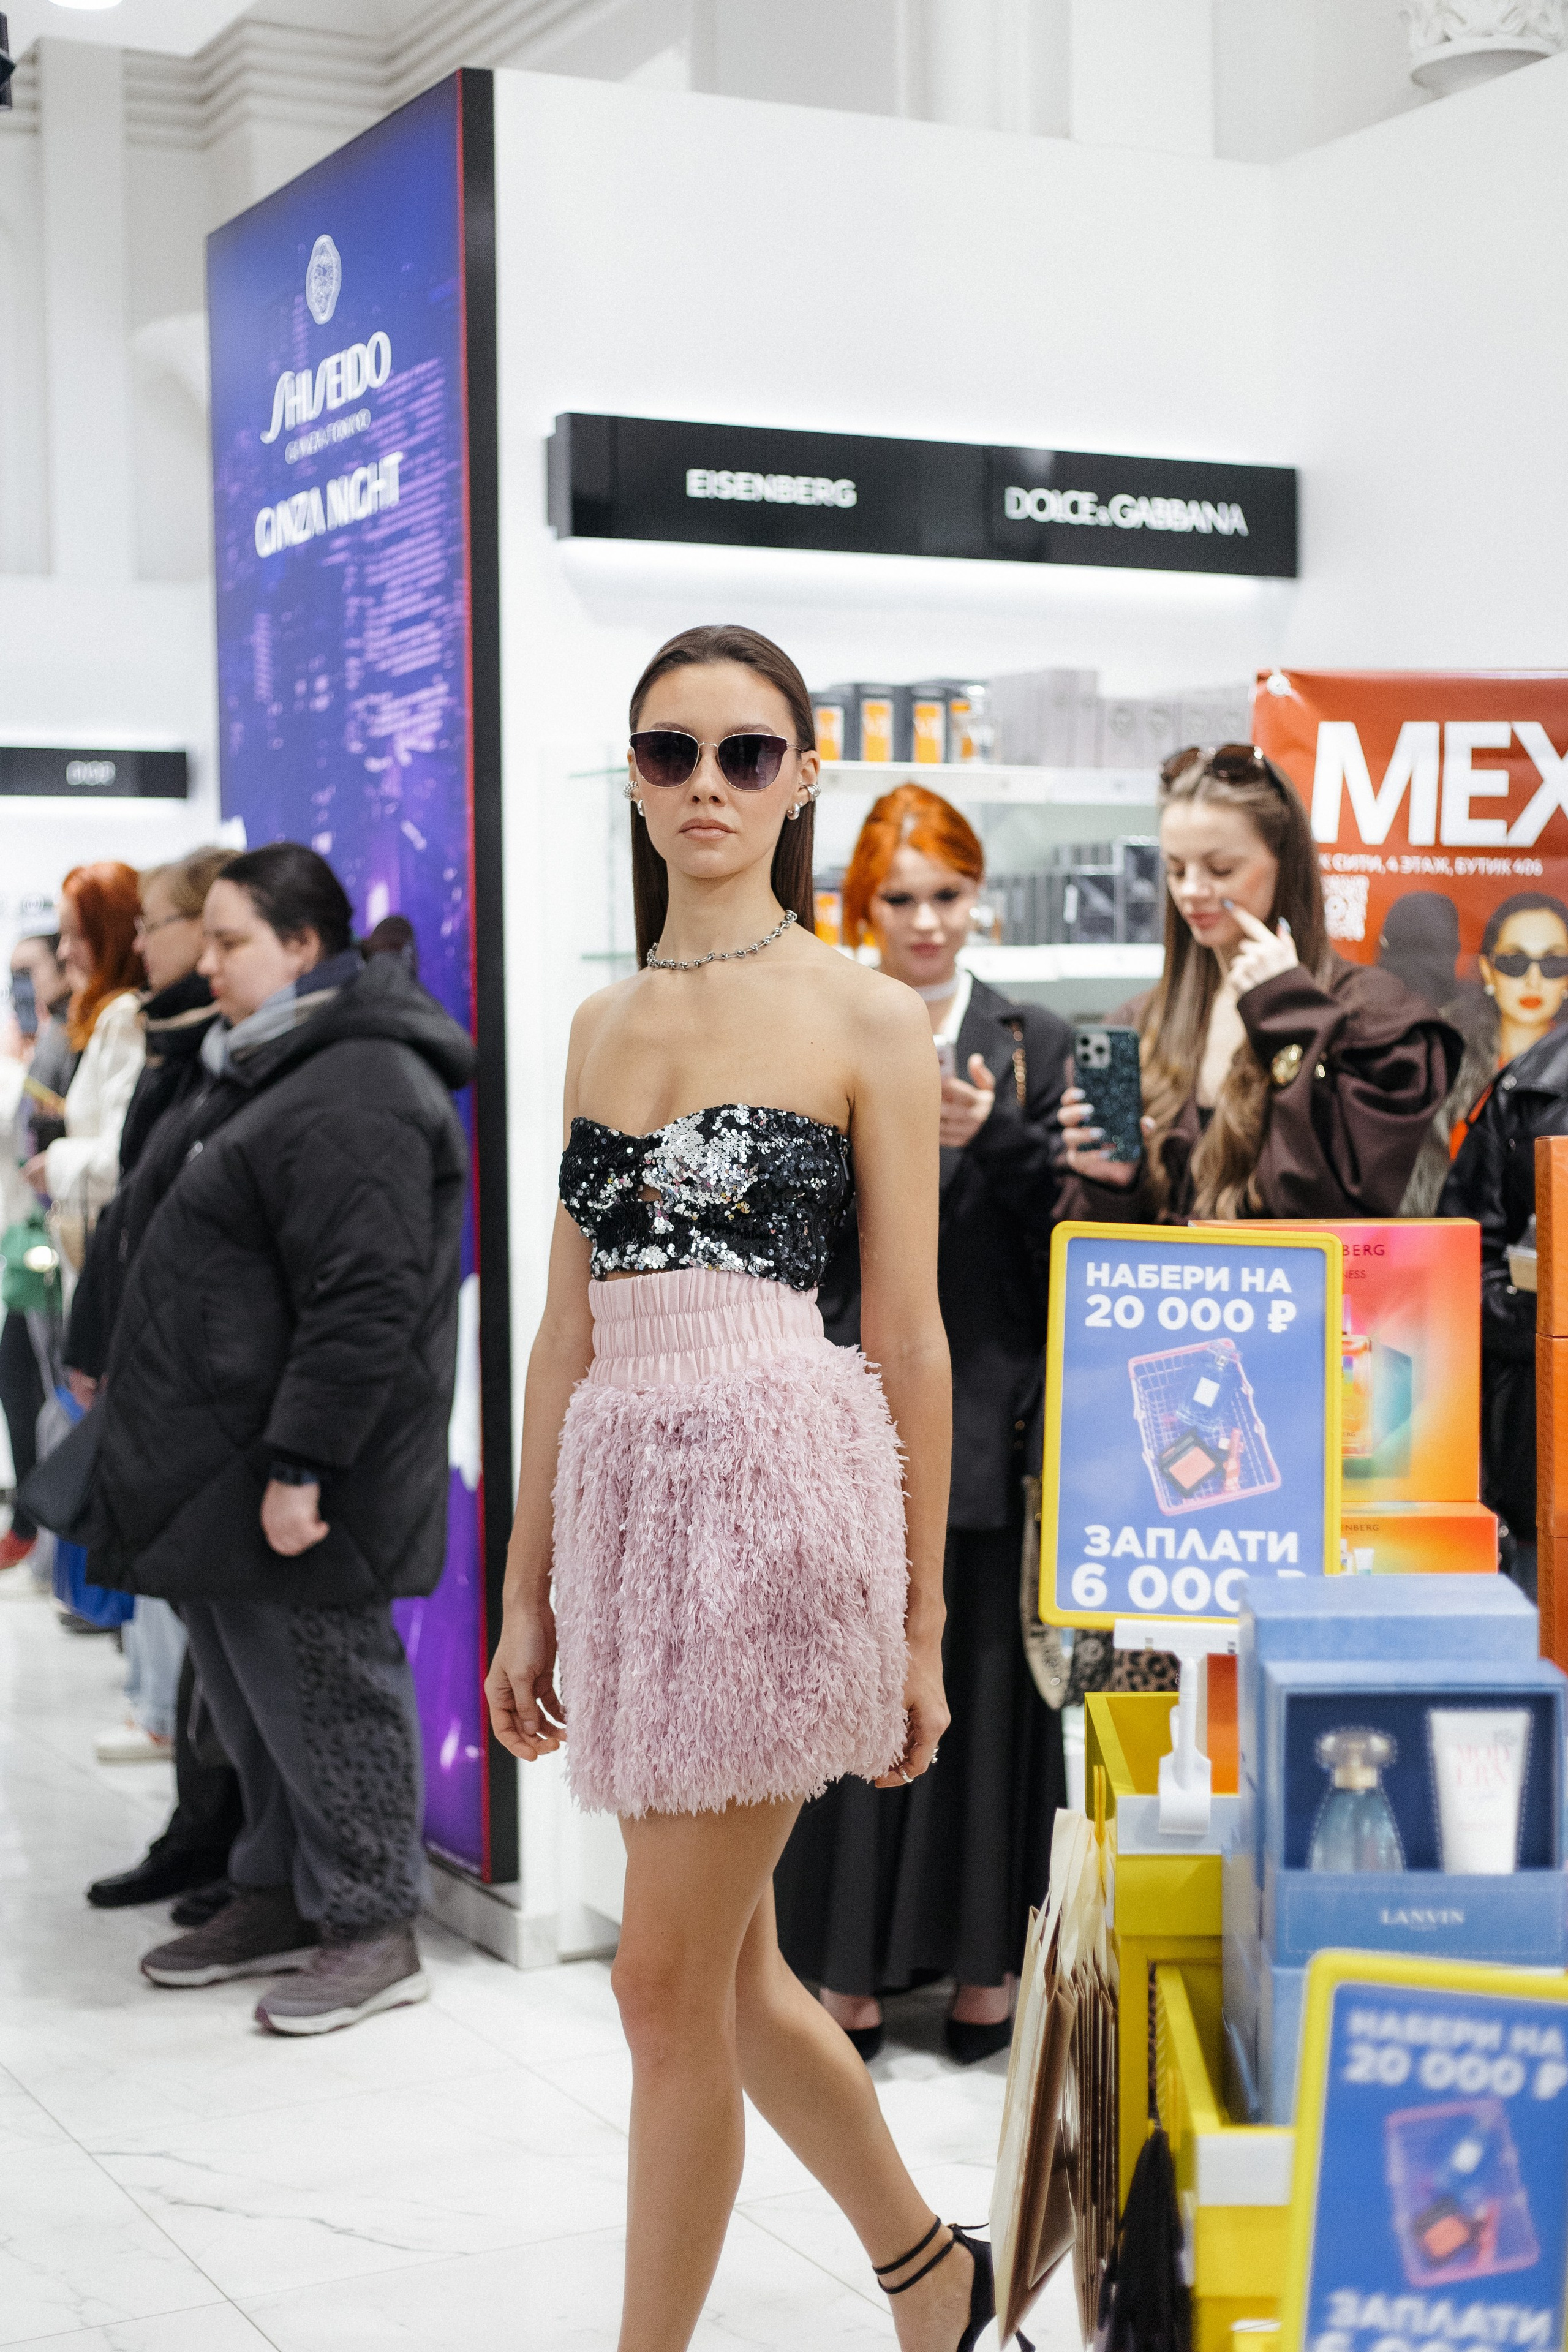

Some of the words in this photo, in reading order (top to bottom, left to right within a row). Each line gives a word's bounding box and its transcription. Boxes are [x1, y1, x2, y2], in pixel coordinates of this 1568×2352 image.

[260, 331, 391, 444] SHISEIDO
[686, 468, 858, 508] EISENBERG
[1454, 856, 1512, 876] БУТИК
[1086, 1262, 1229, 1292] НАБЕРИ
[1241, 1267, 1292, 1293] НА
[1085, 1294, 1144, 1329] 20
[1158, 1297, 1254, 1333] 000
[1084, 1524, 1298, 1563] ЗАПЛАТИ
[1071, 1562, 1108, 1607] 6
[1379, 1907, 1465, 1925] LANVIN
[1344, 2043, 1410, 2086] 20
[1420, 2052, 1525, 2098] 000
[1328, 2288, 1553, 2346] ЗАПЛАТИ
